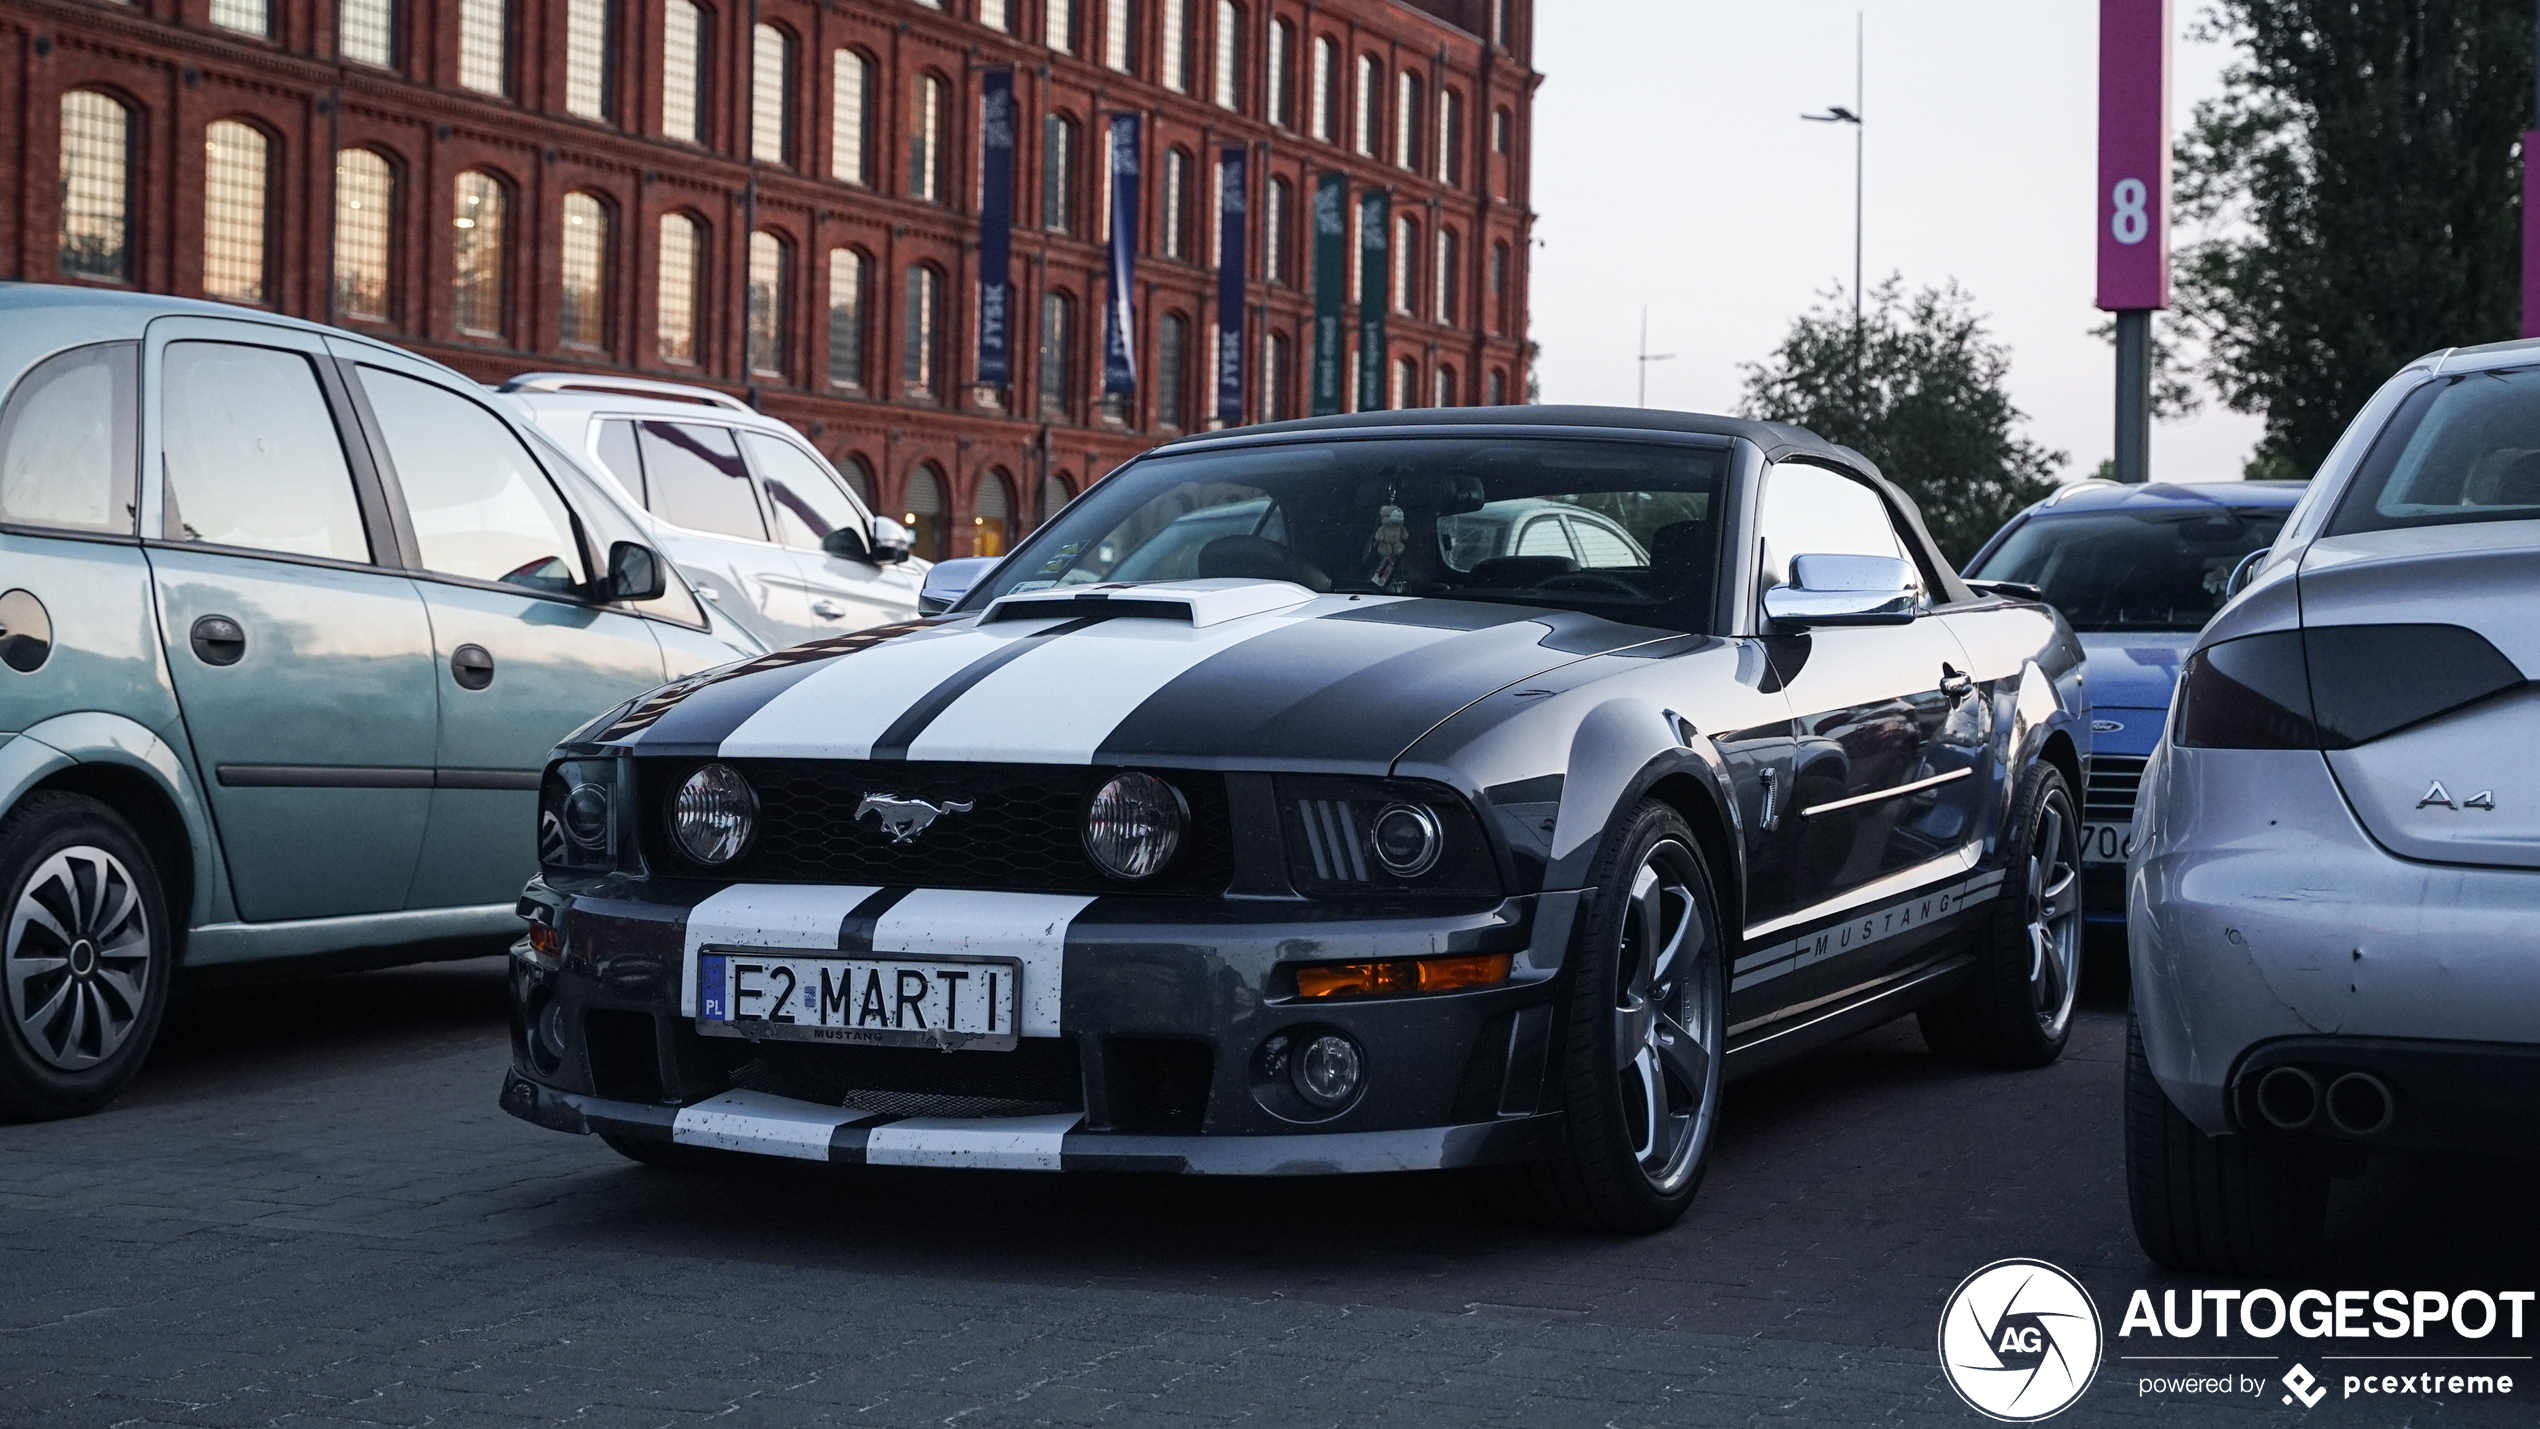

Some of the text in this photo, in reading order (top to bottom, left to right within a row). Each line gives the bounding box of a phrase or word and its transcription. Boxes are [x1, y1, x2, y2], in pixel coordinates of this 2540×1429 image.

[2112, 177, 2149, 245] 8
[983, 284, 1005, 350] JYSK
[1222, 330, 1240, 388] JYSK
[2415, 780, 2495, 811] A4
[1814, 894, 1949, 957] MUSTANG
[706, 1000, 722, 1015] PL
[734, 964, 997, 1031] E2 MARTI
[814, 1029, 882, 1042] MUSTANG
